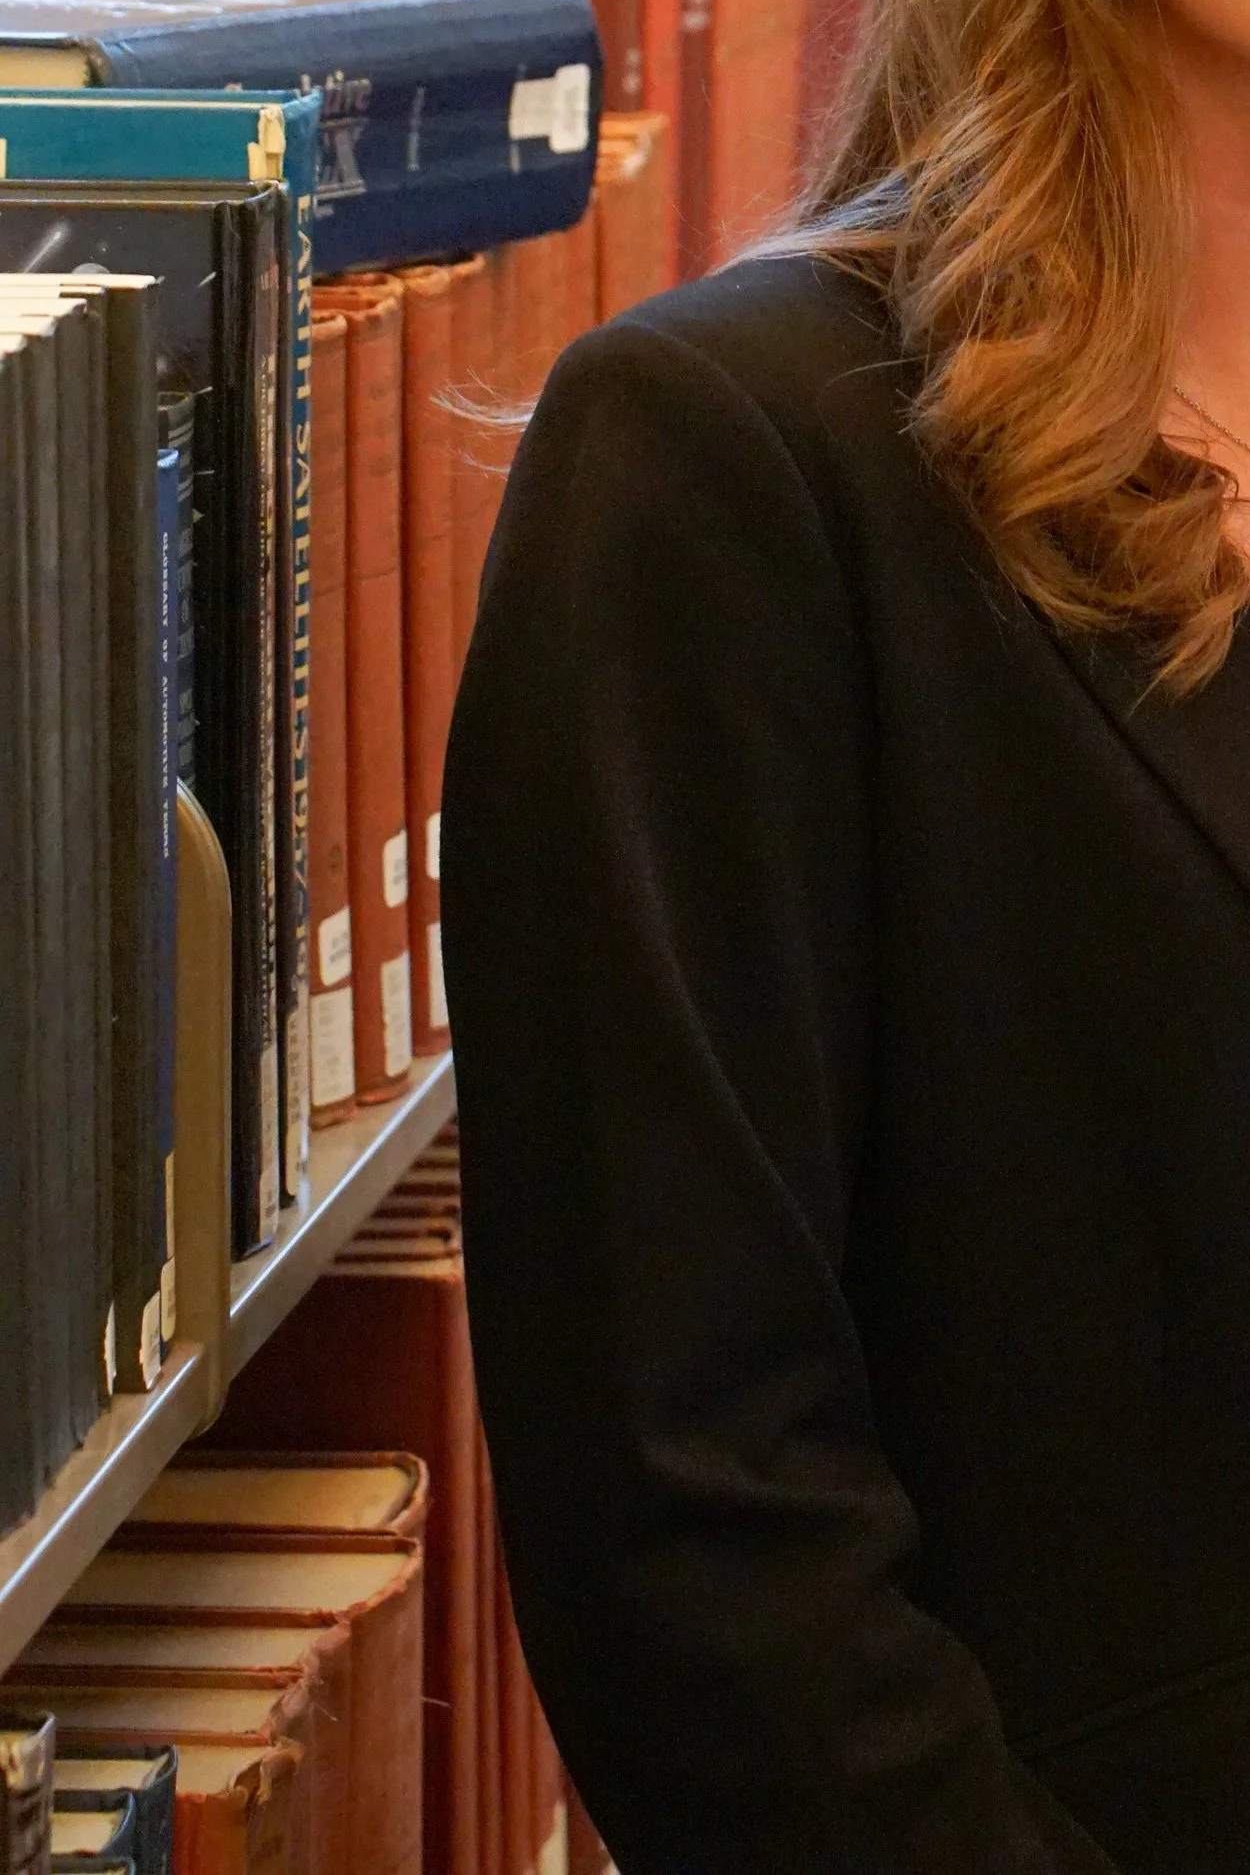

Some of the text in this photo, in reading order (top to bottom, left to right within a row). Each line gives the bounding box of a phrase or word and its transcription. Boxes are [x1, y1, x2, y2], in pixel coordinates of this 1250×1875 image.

[297, 194, 312, 400] EARTH
[162, 639, 169, 662] OF
[294, 421, 311, 761] SATELLITES
